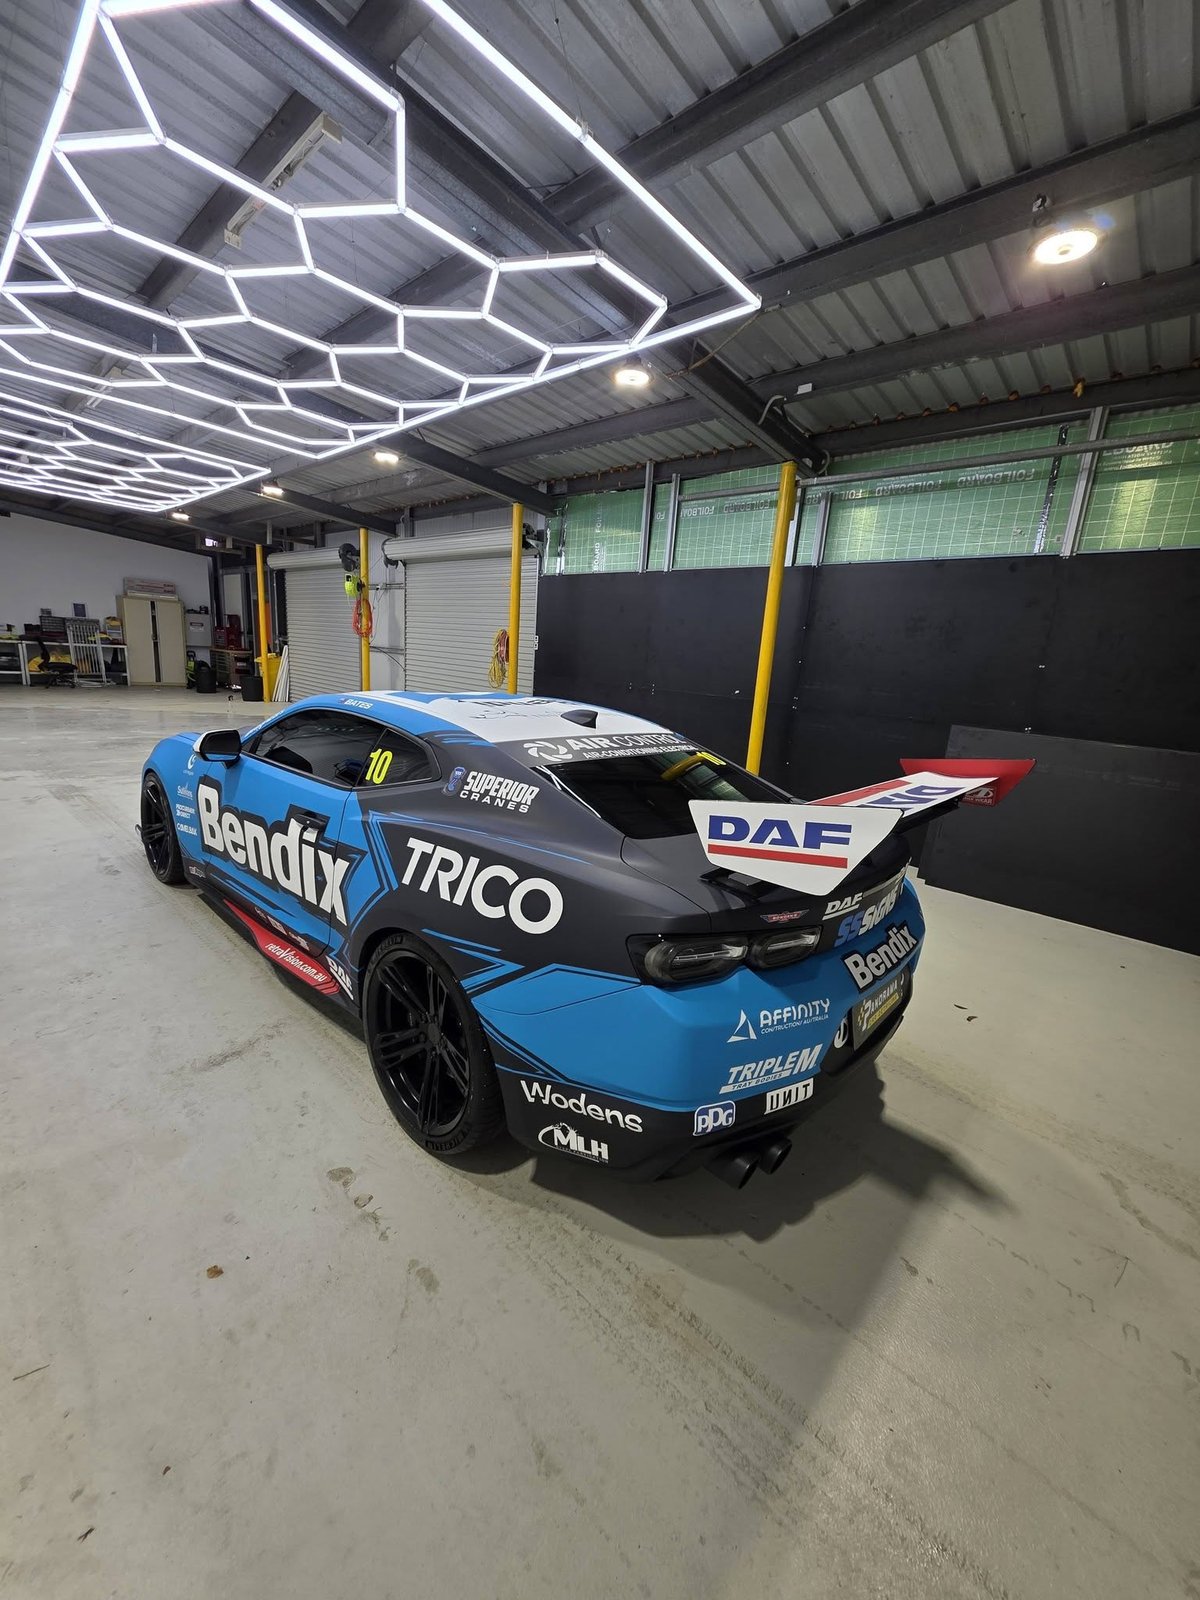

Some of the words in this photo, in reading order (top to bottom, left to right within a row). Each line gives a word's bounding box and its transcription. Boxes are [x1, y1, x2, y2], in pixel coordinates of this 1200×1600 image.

[875, 479, 942, 498] FOILBOARD
[957, 467, 1035, 488] FOILBOARD
[723, 499, 770, 514] FOILBOARD
[566, 737, 619, 751] AIR
[613, 734, 687, 747] CONTROL
[365, 748, 393, 784] 10
[460, 790, 530, 813] CRANES
[463, 770, 540, 805] SUPERIOR
[708, 814, 852, 850] DAF
[197, 783, 350, 926] Bendix
[401, 836, 563, 934] TRICO
[825, 892, 863, 915] DAF
[265, 943, 327, 982] retraVision.com.au
[844, 926, 917, 989] Bendix
[759, 998, 831, 1028] AFFINITY
[732, 1081, 752, 1091] TRAY
[755, 1073, 783, 1085] BODIES
[520, 1080, 643, 1133] Wodens
[697, 1107, 734, 1133] PPG
[553, 1128, 609, 1161] MLH
